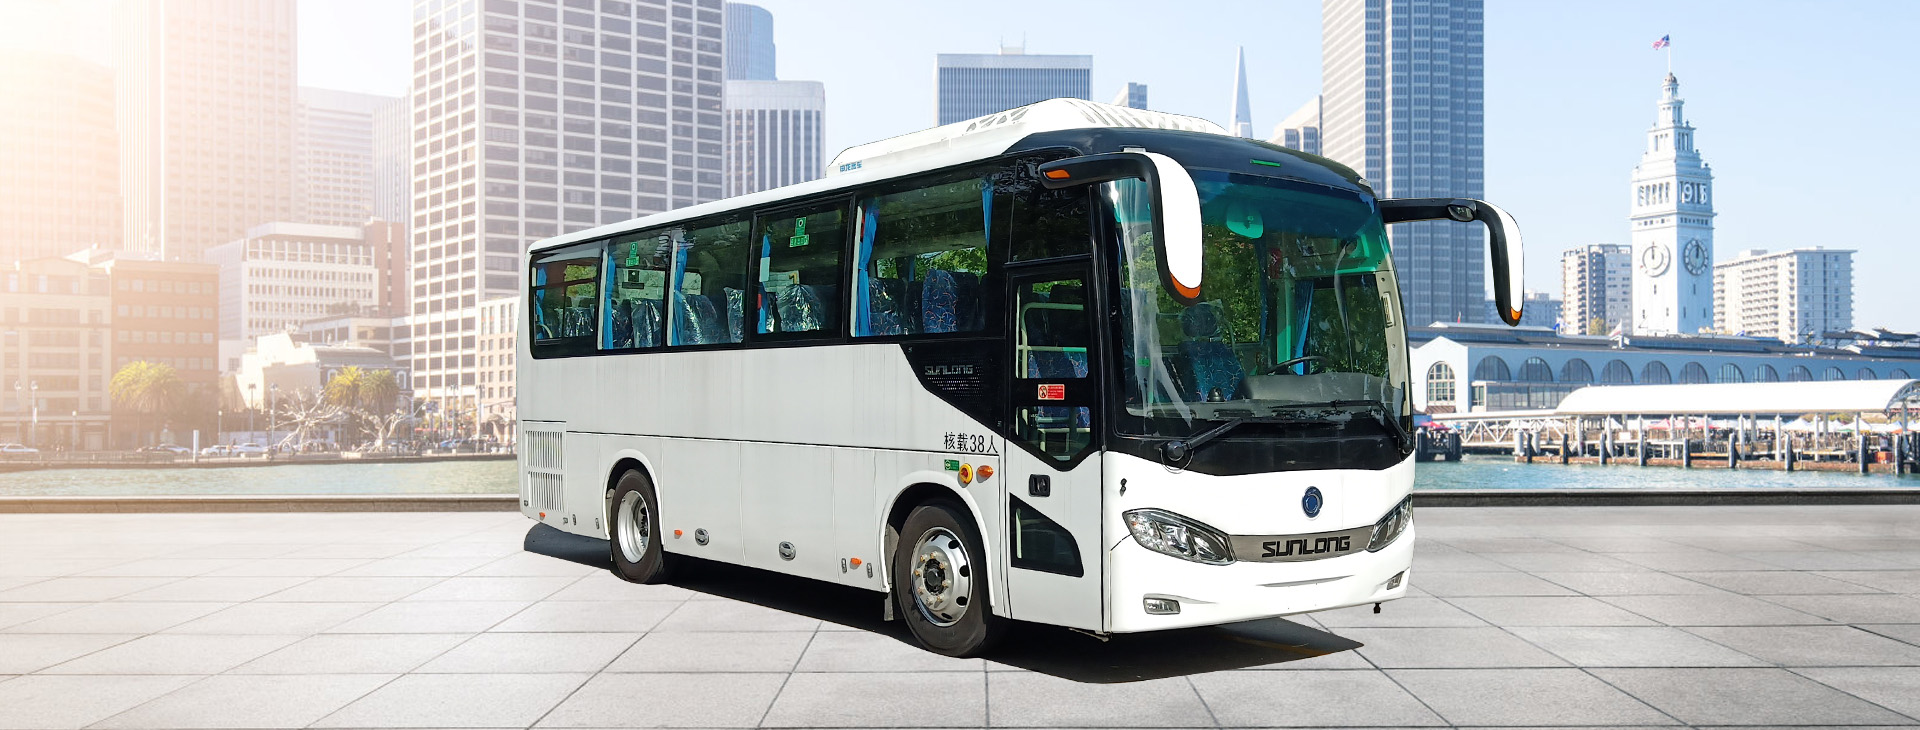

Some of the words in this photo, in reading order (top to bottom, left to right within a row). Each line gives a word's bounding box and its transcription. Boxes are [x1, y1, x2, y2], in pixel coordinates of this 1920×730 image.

[925, 364, 973, 375] SUNLONG
[943, 431, 998, 453] 核载38人
[1261, 535, 1350, 557] SUNLONG
